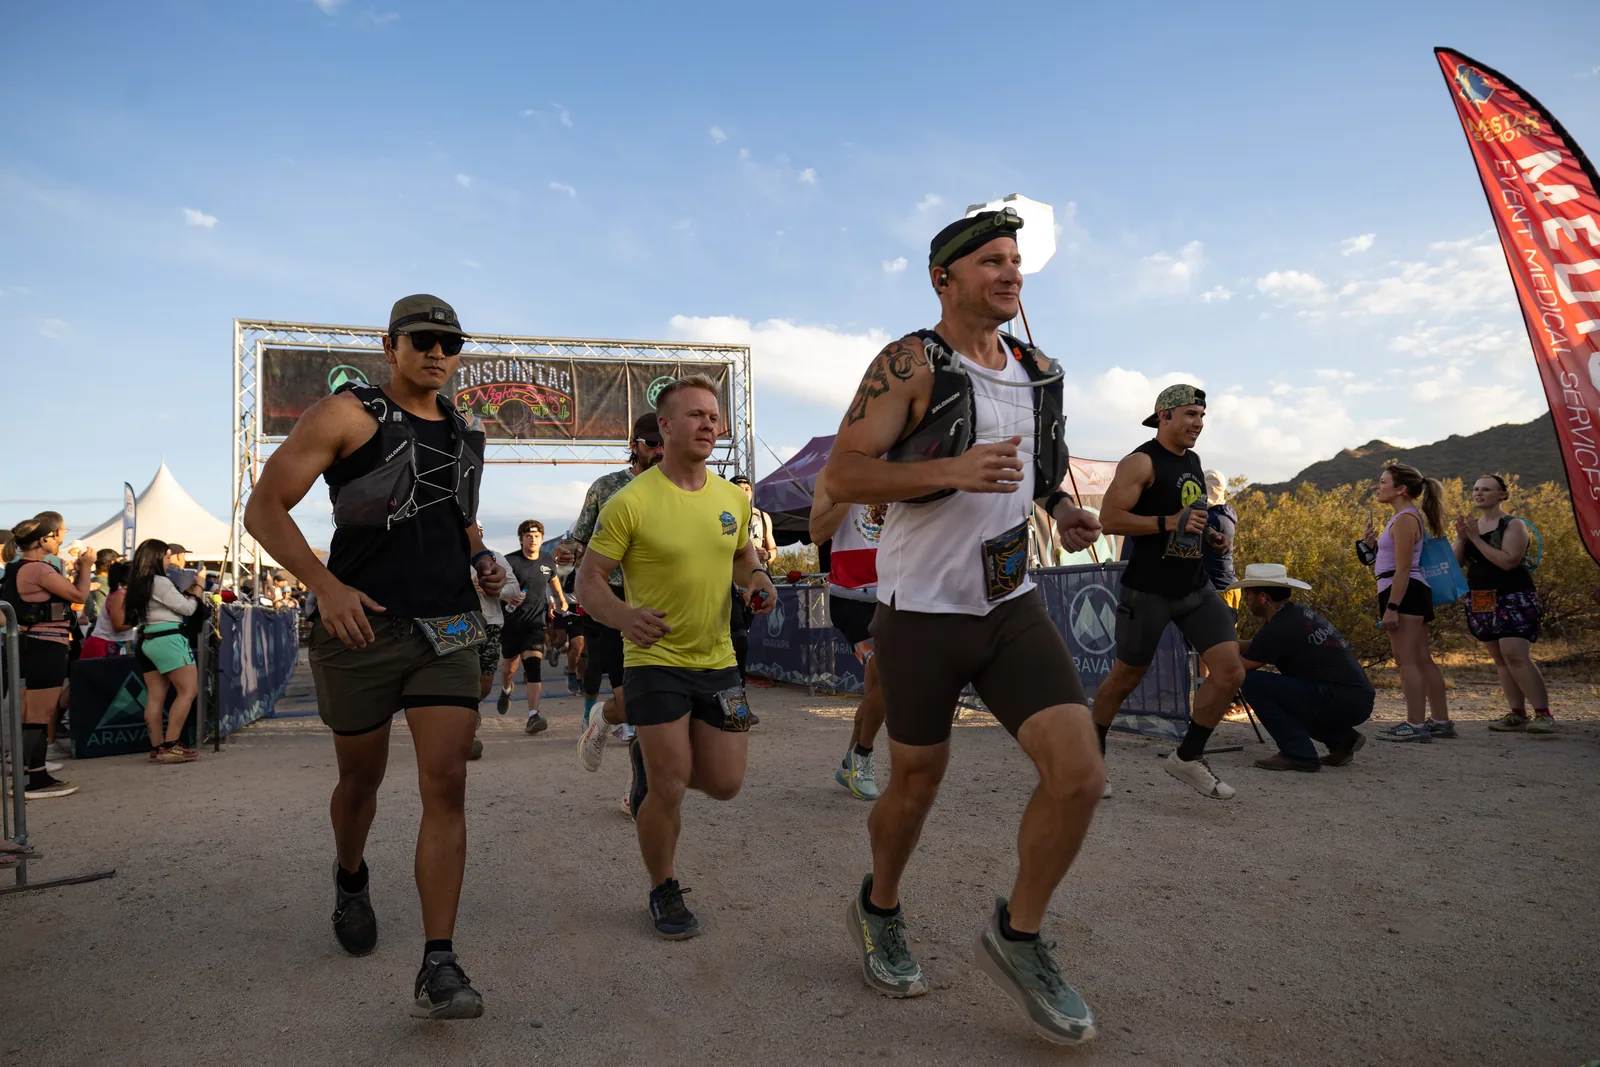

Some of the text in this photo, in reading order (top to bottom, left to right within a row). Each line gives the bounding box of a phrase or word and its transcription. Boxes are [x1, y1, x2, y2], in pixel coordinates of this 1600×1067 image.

[1495, 159, 1534, 240] EVENT
[1524, 249, 1571, 361] MEDICAL
[457, 359, 570, 394] INSOMNIAC
[467, 385, 560, 413] Night Series
[931, 391, 960, 415] SALOMON
[385, 440, 408, 463] SALOMON
[447, 620, 468, 635] 44
[86, 728, 150, 747] ARAVA
[862, 919, 875, 953] HOKA
